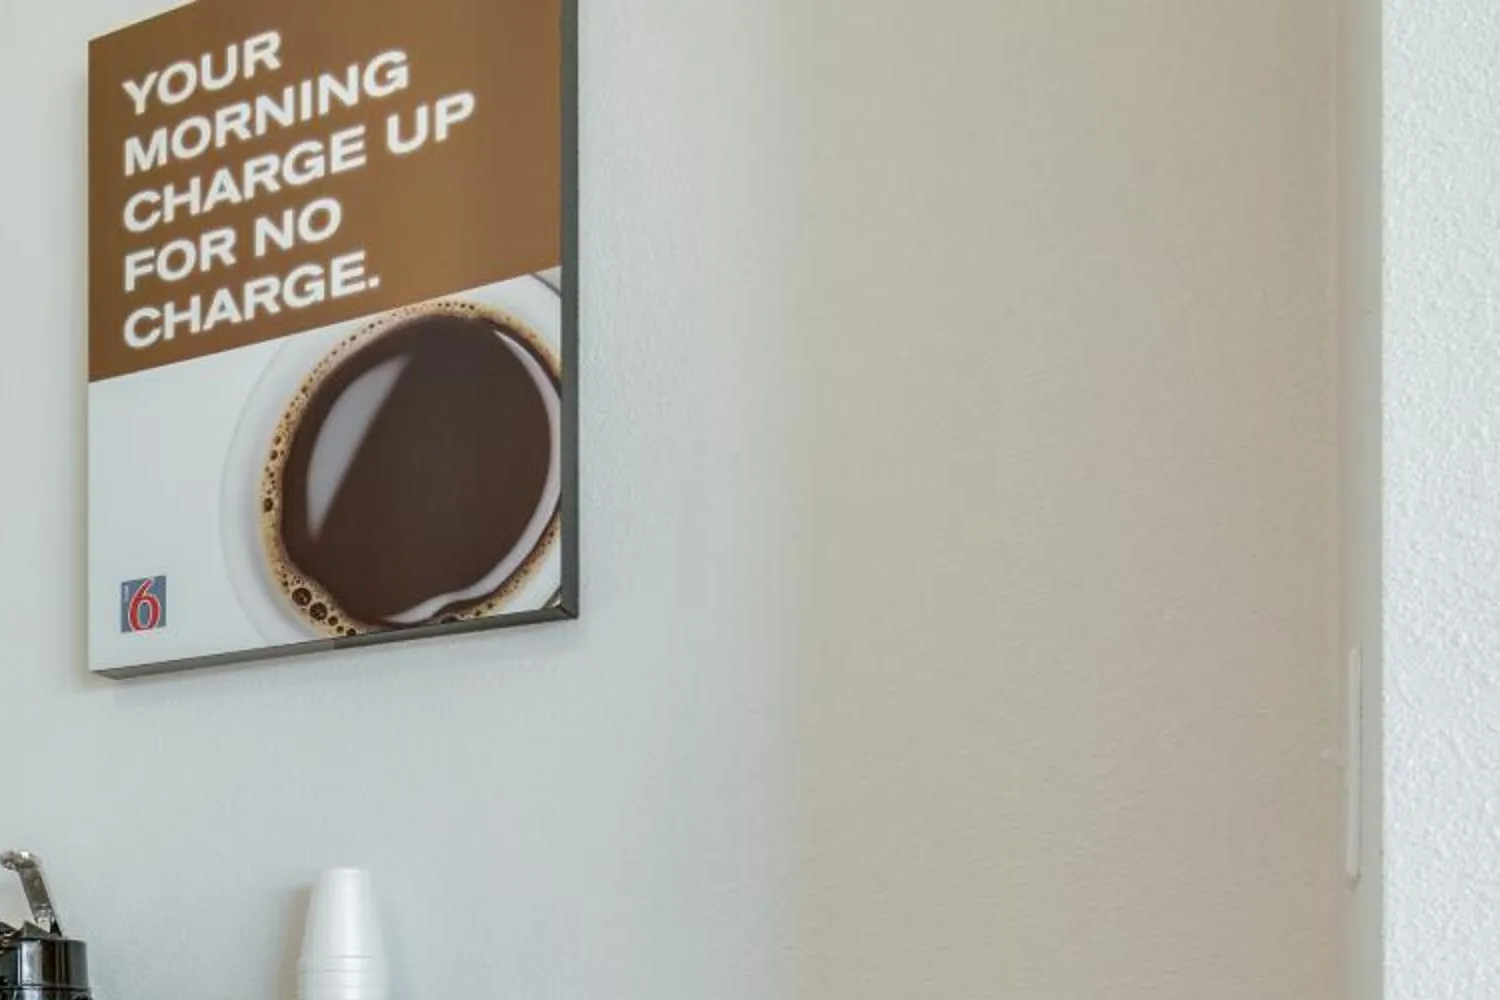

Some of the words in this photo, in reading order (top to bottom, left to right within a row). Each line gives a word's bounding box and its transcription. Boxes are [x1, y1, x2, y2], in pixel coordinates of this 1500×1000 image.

[122, 30, 282, 116] YOUR
[124, 49, 410, 177] MORNING
[123, 124, 368, 233] CHARGE
[385, 91, 477, 155] UP
[124, 227, 238, 293] FOR
[253, 197, 343, 258] NO
[123, 250, 381, 350] CHARGE.
[128, 578, 161, 633] 6
